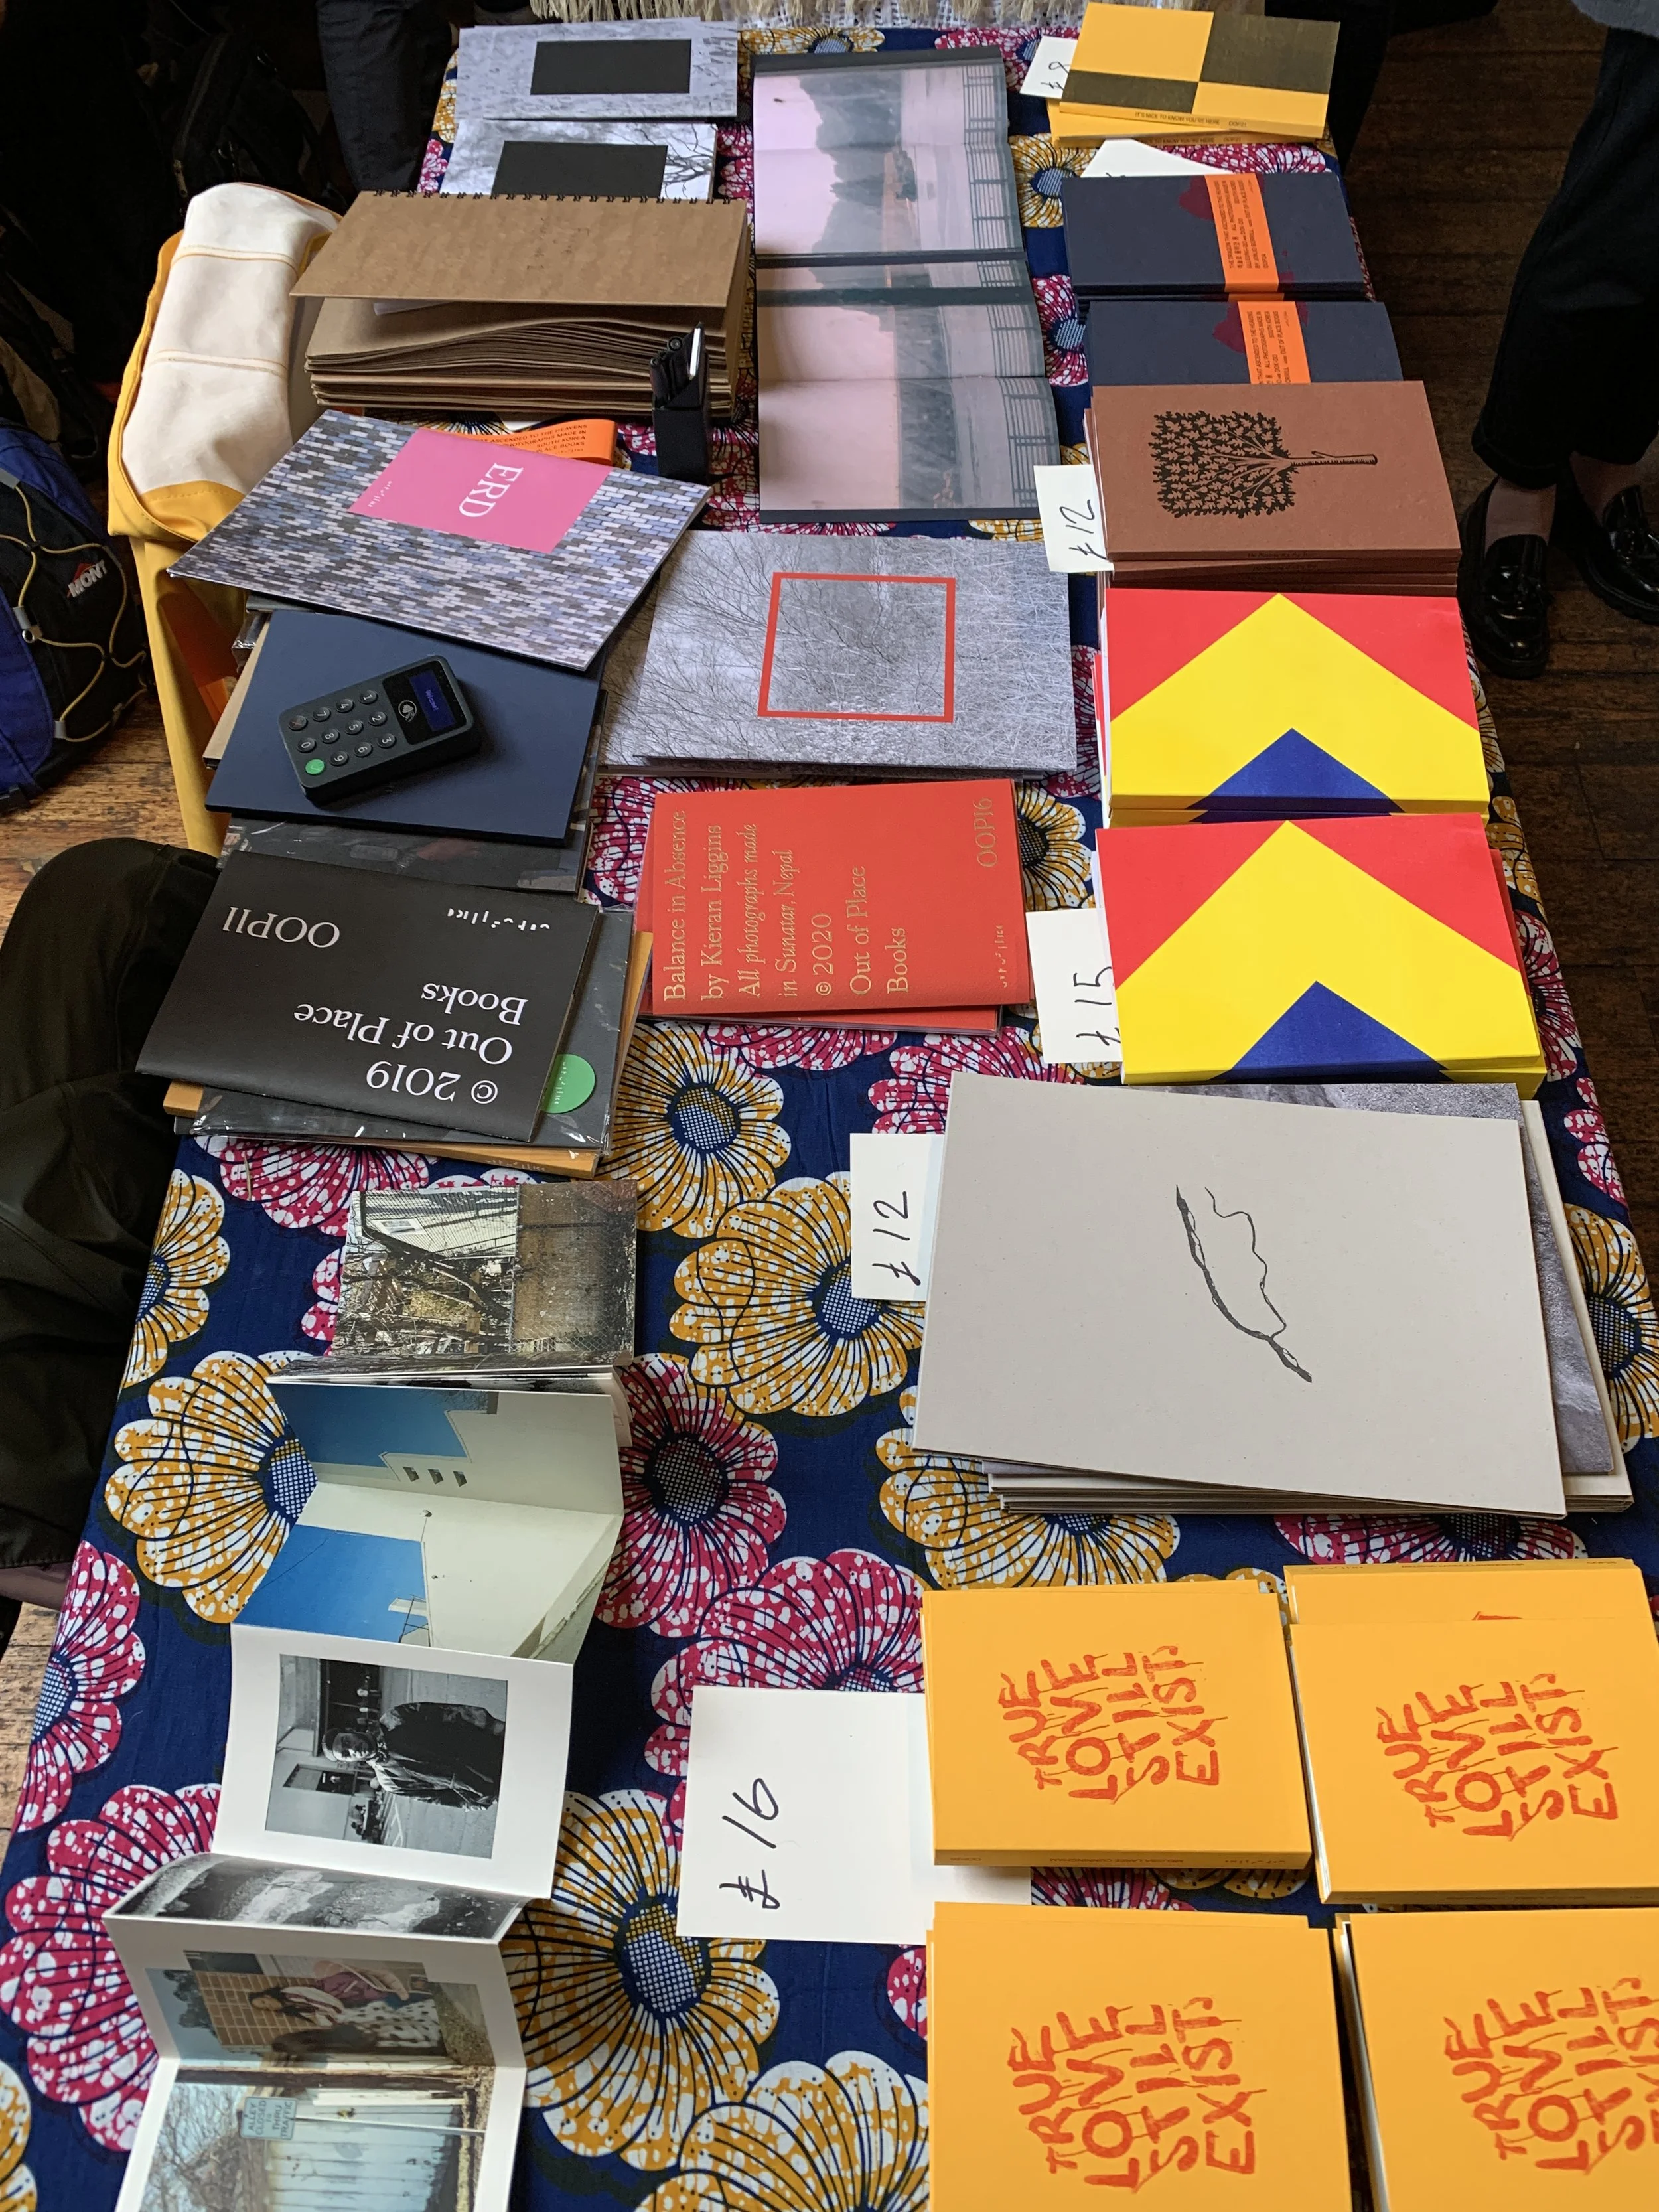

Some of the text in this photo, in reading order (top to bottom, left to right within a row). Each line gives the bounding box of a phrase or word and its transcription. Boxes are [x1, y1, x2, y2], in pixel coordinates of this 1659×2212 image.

[490, 435, 528, 444] ASCENDED
[459, 462, 524, 518] ERD
[1060, 499, 1108, 560] £12
[68, 559, 108, 598] MONT
[772, 849, 800, 897] Nepal
[973, 797, 998, 867] OOP16
[663, 810, 686, 1001] Balance in Absence
[700, 824, 729, 1001] by Kieran Liggins
[735, 823, 766, 998] All photographs made
[811, 913, 834, 976] 2020
[845, 865, 872, 995] Out of Place
[420, 982, 529, 1026] Books
[778, 979, 798, 998] in
[884, 928, 908, 994] Books
[1073, 966, 1121, 1046] £15
[293, 1003, 513, 1065] Out of Place
[366, 1060, 462, 1102] 2019
[871, 1191, 922, 1286] £12
[997, 1670, 1062, 1791] TRUE
[1040, 1655, 1118, 1800] LOVE
[1102, 1652, 1170, 1795] STILL
[1376, 1704, 1455, 1828] TRUE
[1415, 1685, 1513, 1836] LOVE
[1480, 1682, 1564, 1833] STILL
[719, 1777, 780, 1909] £16
[248, 2102, 257, 2132] ALLEY
[255, 2100, 267, 2136] CLOSED
[272, 2104, 283, 2130] THRU
[281, 2101, 293, 2137] TRAFFIC
[1007, 2026, 1078, 2174] TRUE
[1056, 2006, 1139, 2189] LOVE
[1125, 2004, 1200, 2185] STILL
[1443, 2013, 1528, 2161] TRUE
[1487, 1990, 1589, 2171] LOVE
[1557, 1987, 1646, 2166] STILL
